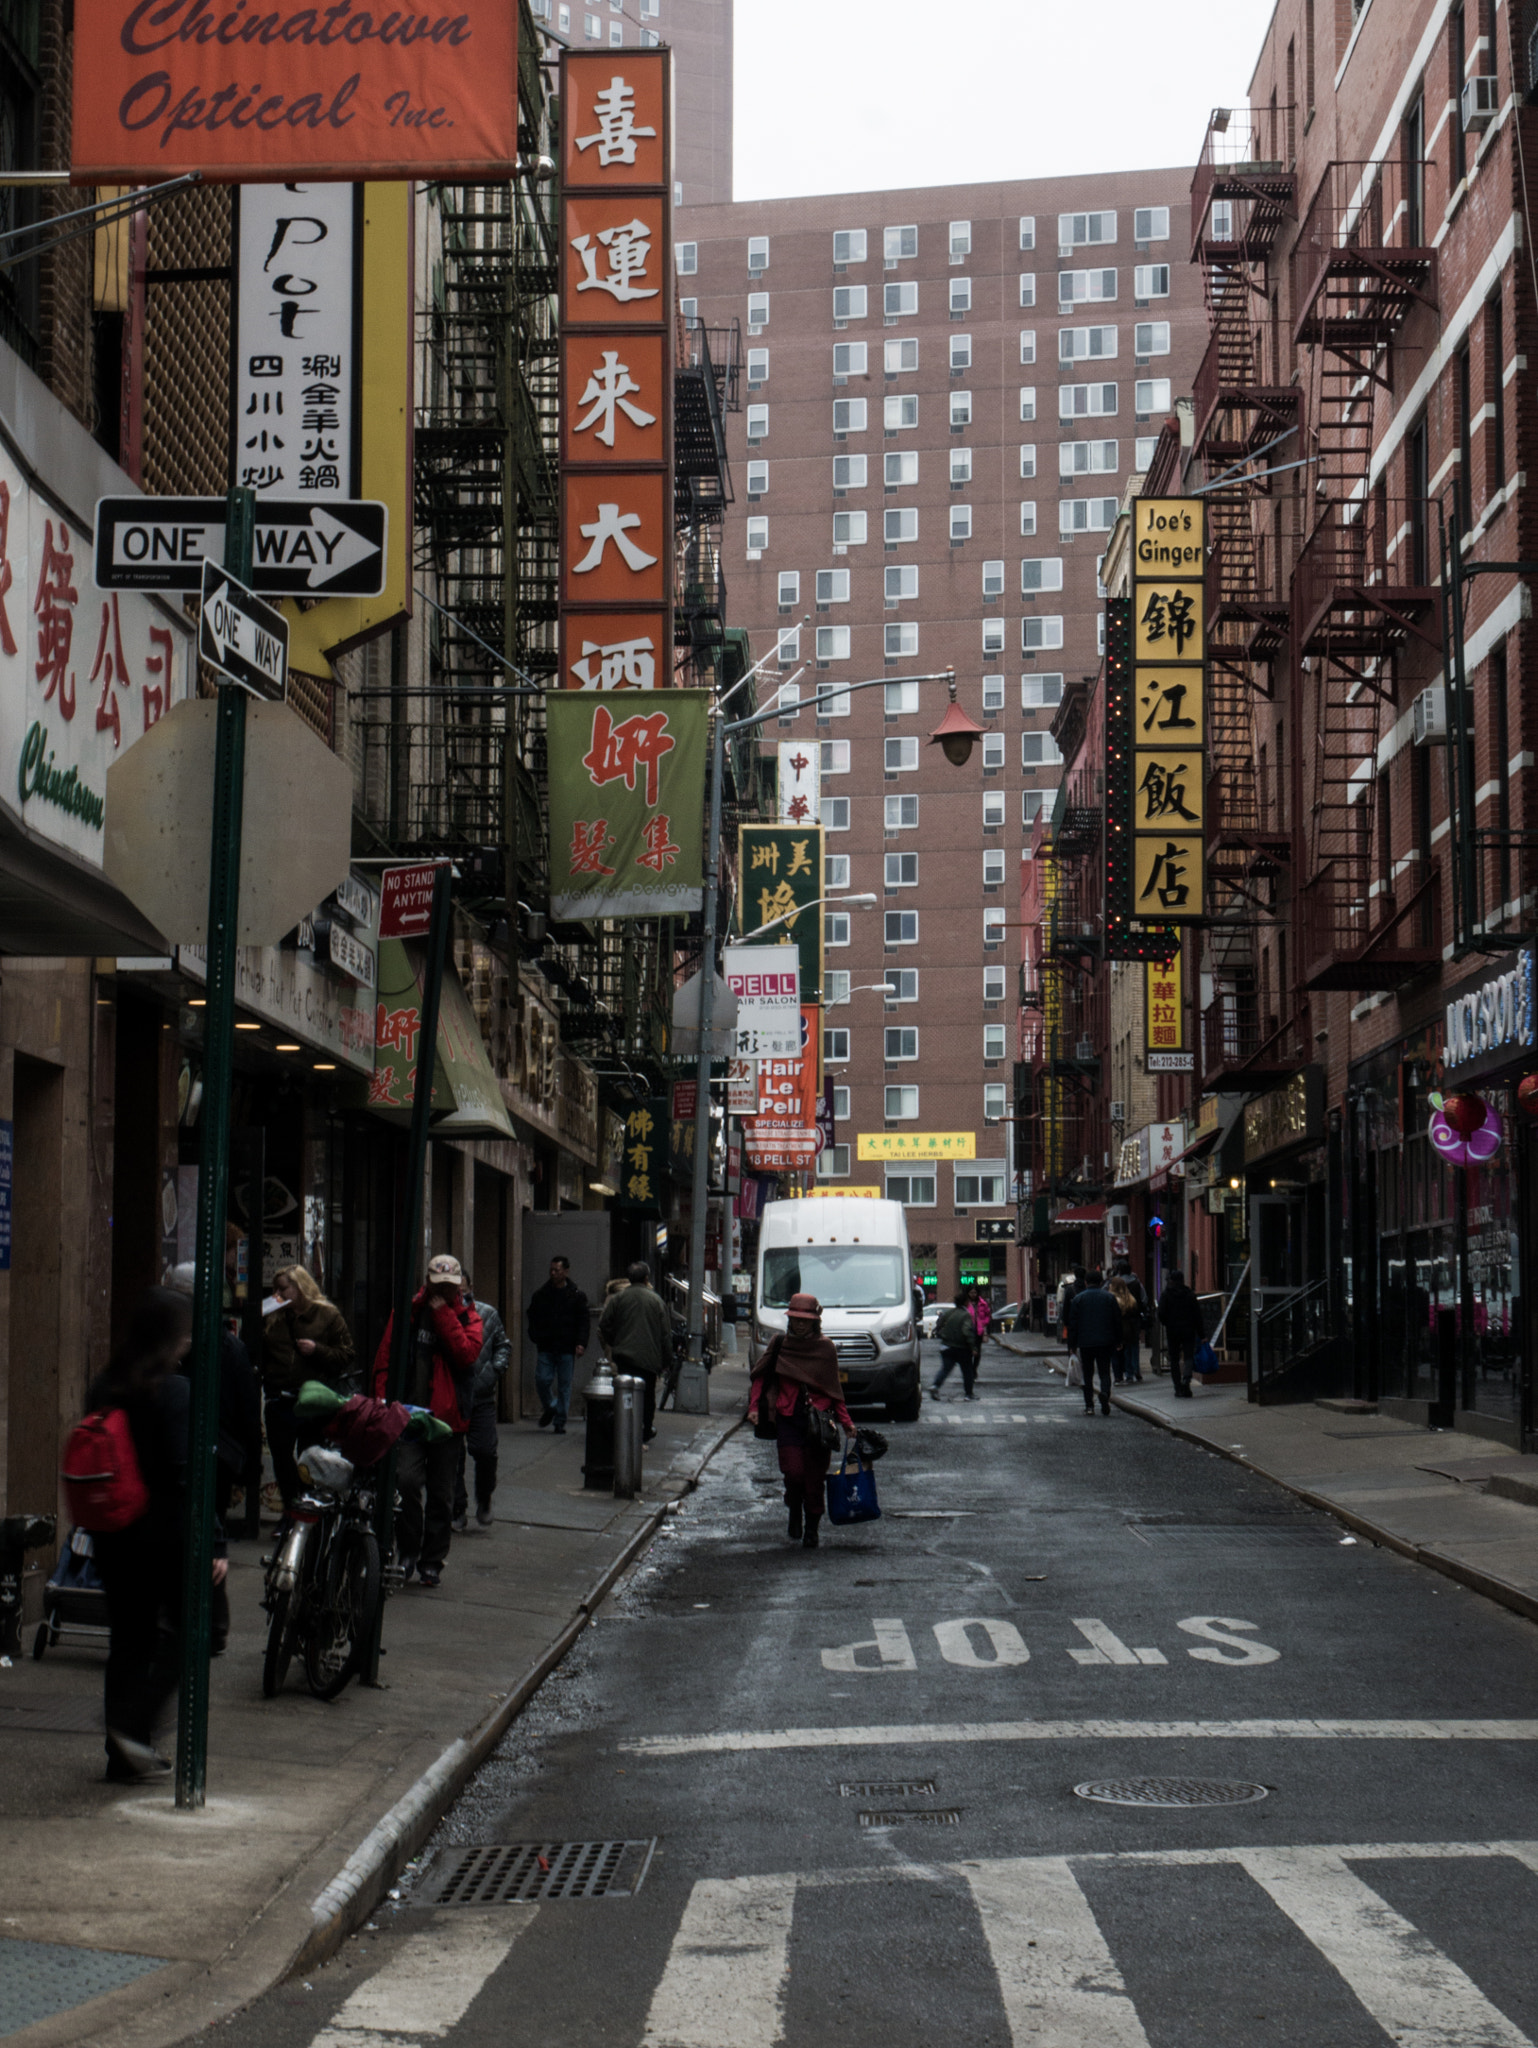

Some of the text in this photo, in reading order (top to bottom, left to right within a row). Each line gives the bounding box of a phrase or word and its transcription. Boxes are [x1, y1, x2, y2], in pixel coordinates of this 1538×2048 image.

[119, 0, 472, 55] Chinatown
[119, 71, 455, 148] Optical Inc.
[242, 355, 284, 488] 四川小炒
[299, 355, 341, 489] 涮全羊火鍋
[1146, 509, 1192, 533] Joe's
[123, 527, 345, 566] ONE WAY
[1137, 540, 1203, 568] Ginger
[0, 480, 174, 748] 鏡公司
[214, 600, 281, 676] ONE WAY
[1138, 589, 1201, 909] 錦江飯店
[19, 720, 104, 831] Chinatown
[387, 876, 401, 891] NO
[633, 883, 689, 898] Design
[393, 890, 434, 908] ANYTIM
[729, 975, 796, 995] PELL
[760, 996, 798, 1005] SALON
[757, 1060, 804, 1077] Hair
[765, 1079, 794, 1096] Le
[758, 1098, 801, 1115] Pell
[754, 1119, 805, 1129] SPECIALIZE
[764, 1154, 793, 1165] PELL
[796, 1154, 811, 1165] ST
[821, 1615, 1282, 1672] STOP
